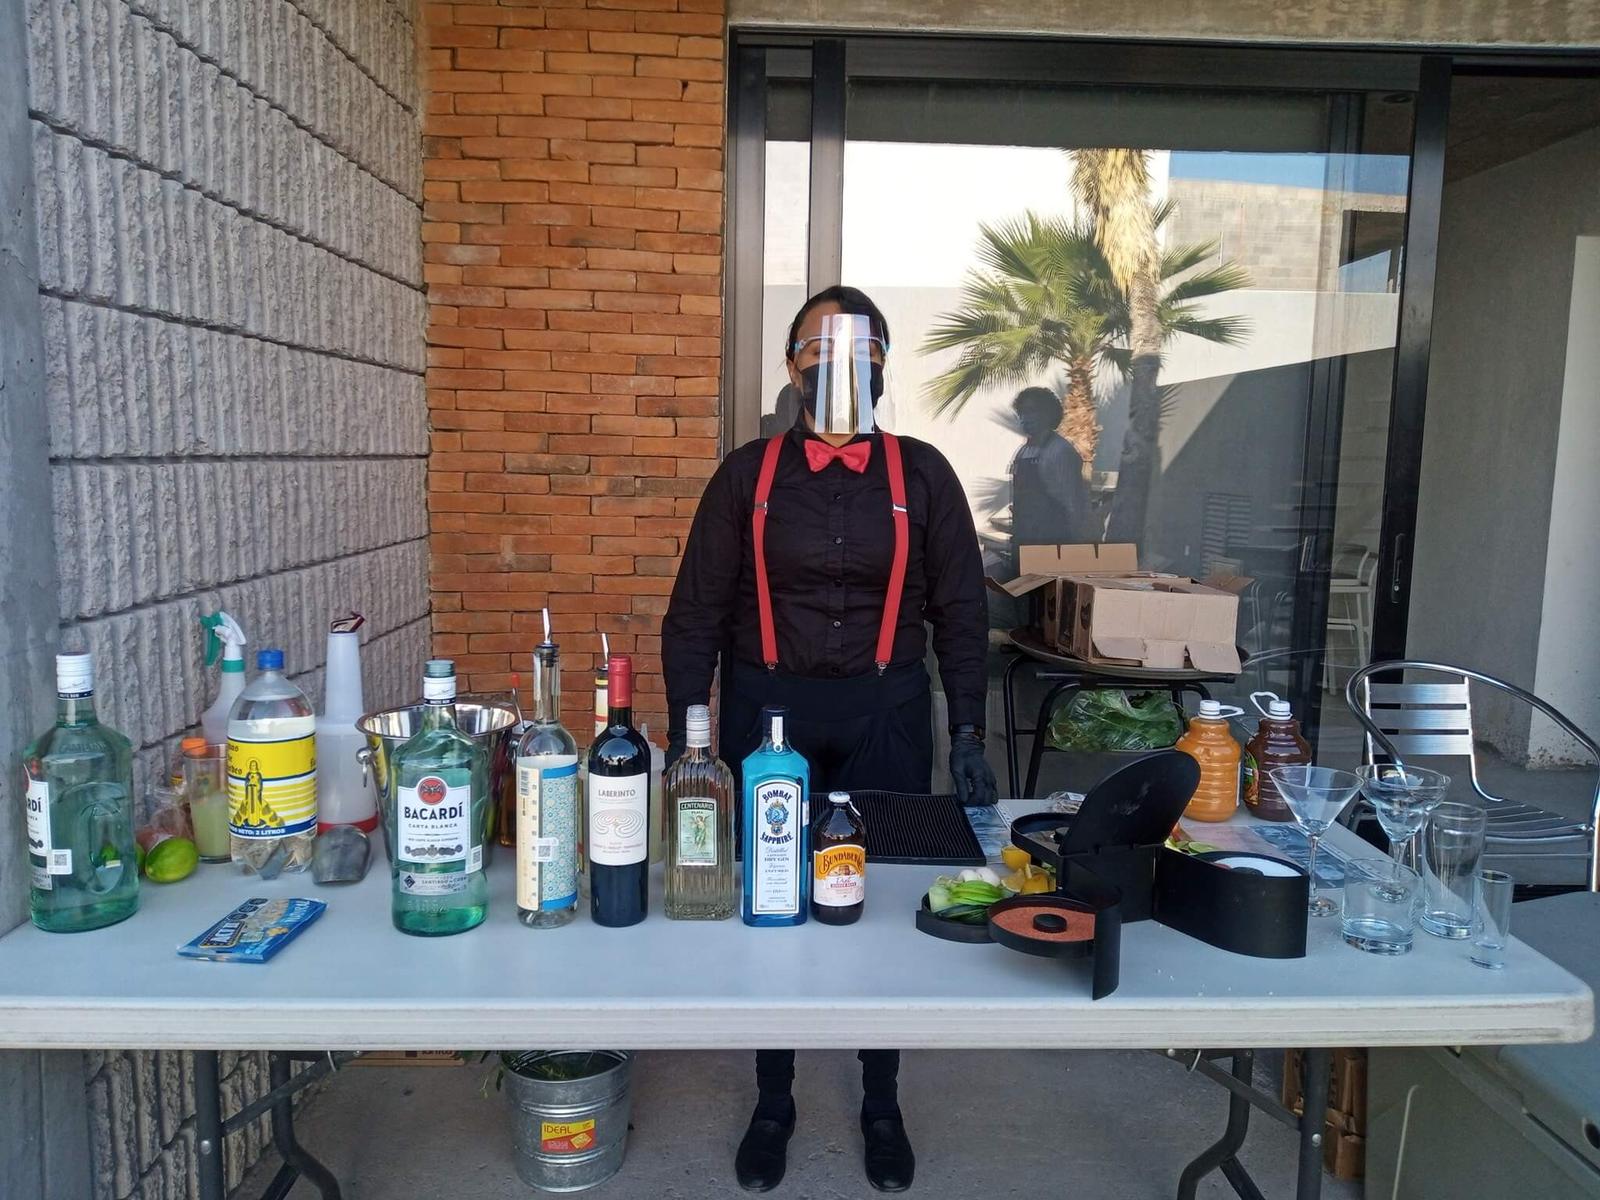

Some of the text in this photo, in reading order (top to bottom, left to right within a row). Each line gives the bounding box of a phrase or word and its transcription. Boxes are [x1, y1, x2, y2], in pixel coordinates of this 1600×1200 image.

[598, 788, 636, 798] LABERINTO
[762, 790, 792, 803] BOMBAY
[404, 802, 463, 820] BACARDÍ
[760, 831, 793, 844] SAPPHIRE
[543, 1123, 573, 1135] IDEAL
